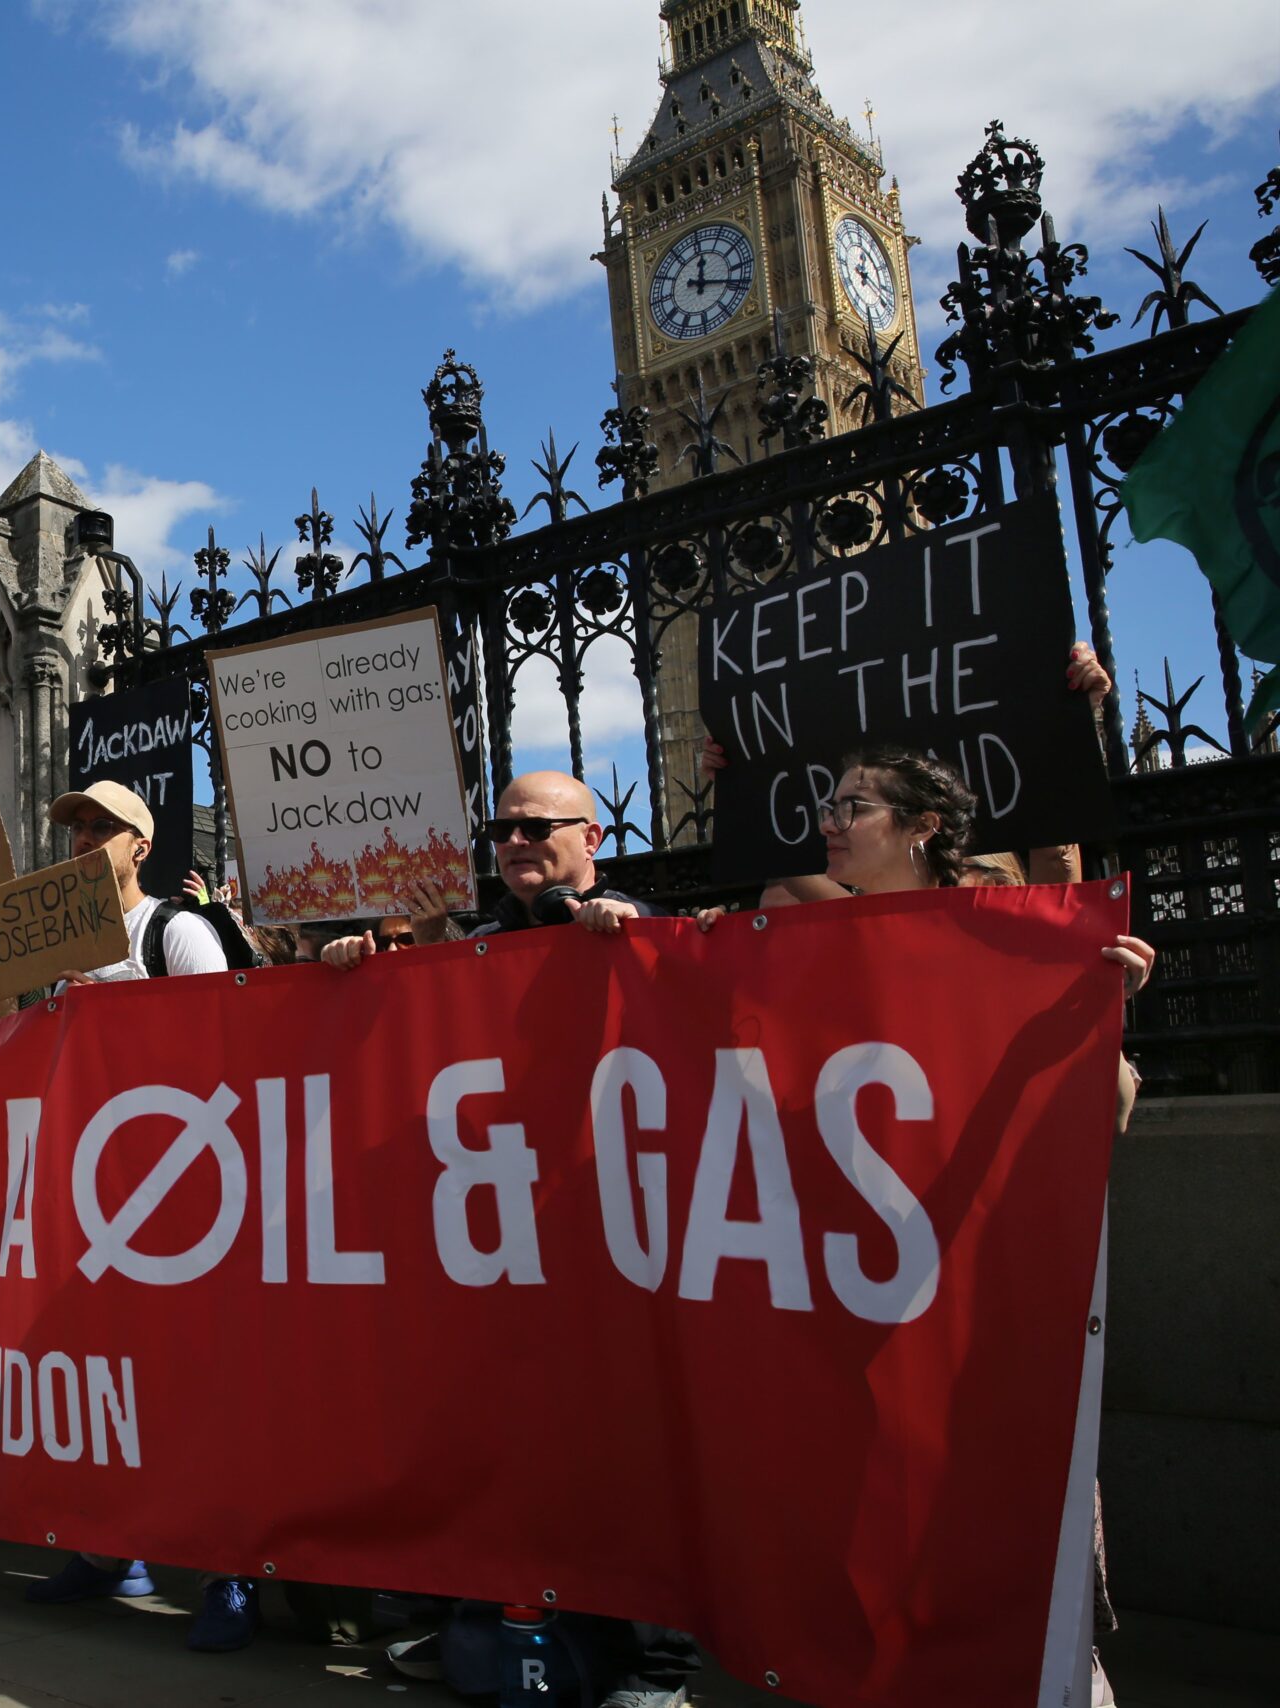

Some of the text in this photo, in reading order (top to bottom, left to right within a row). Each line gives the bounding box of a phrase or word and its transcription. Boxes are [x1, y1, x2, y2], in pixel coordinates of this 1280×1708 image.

[713, 522, 1001, 680] KEEP IT
[218, 644, 420, 696] We're already
[731, 634, 998, 760] IN THE
[225, 680, 441, 731] cooking with gas:
[78, 708, 189, 774] JACKDAW
[269, 739, 382, 782] NO to
[266, 790, 422, 834] Jackdaw
[426, 1057, 546, 1287] &
[590, 1041, 940, 1323] GAS
